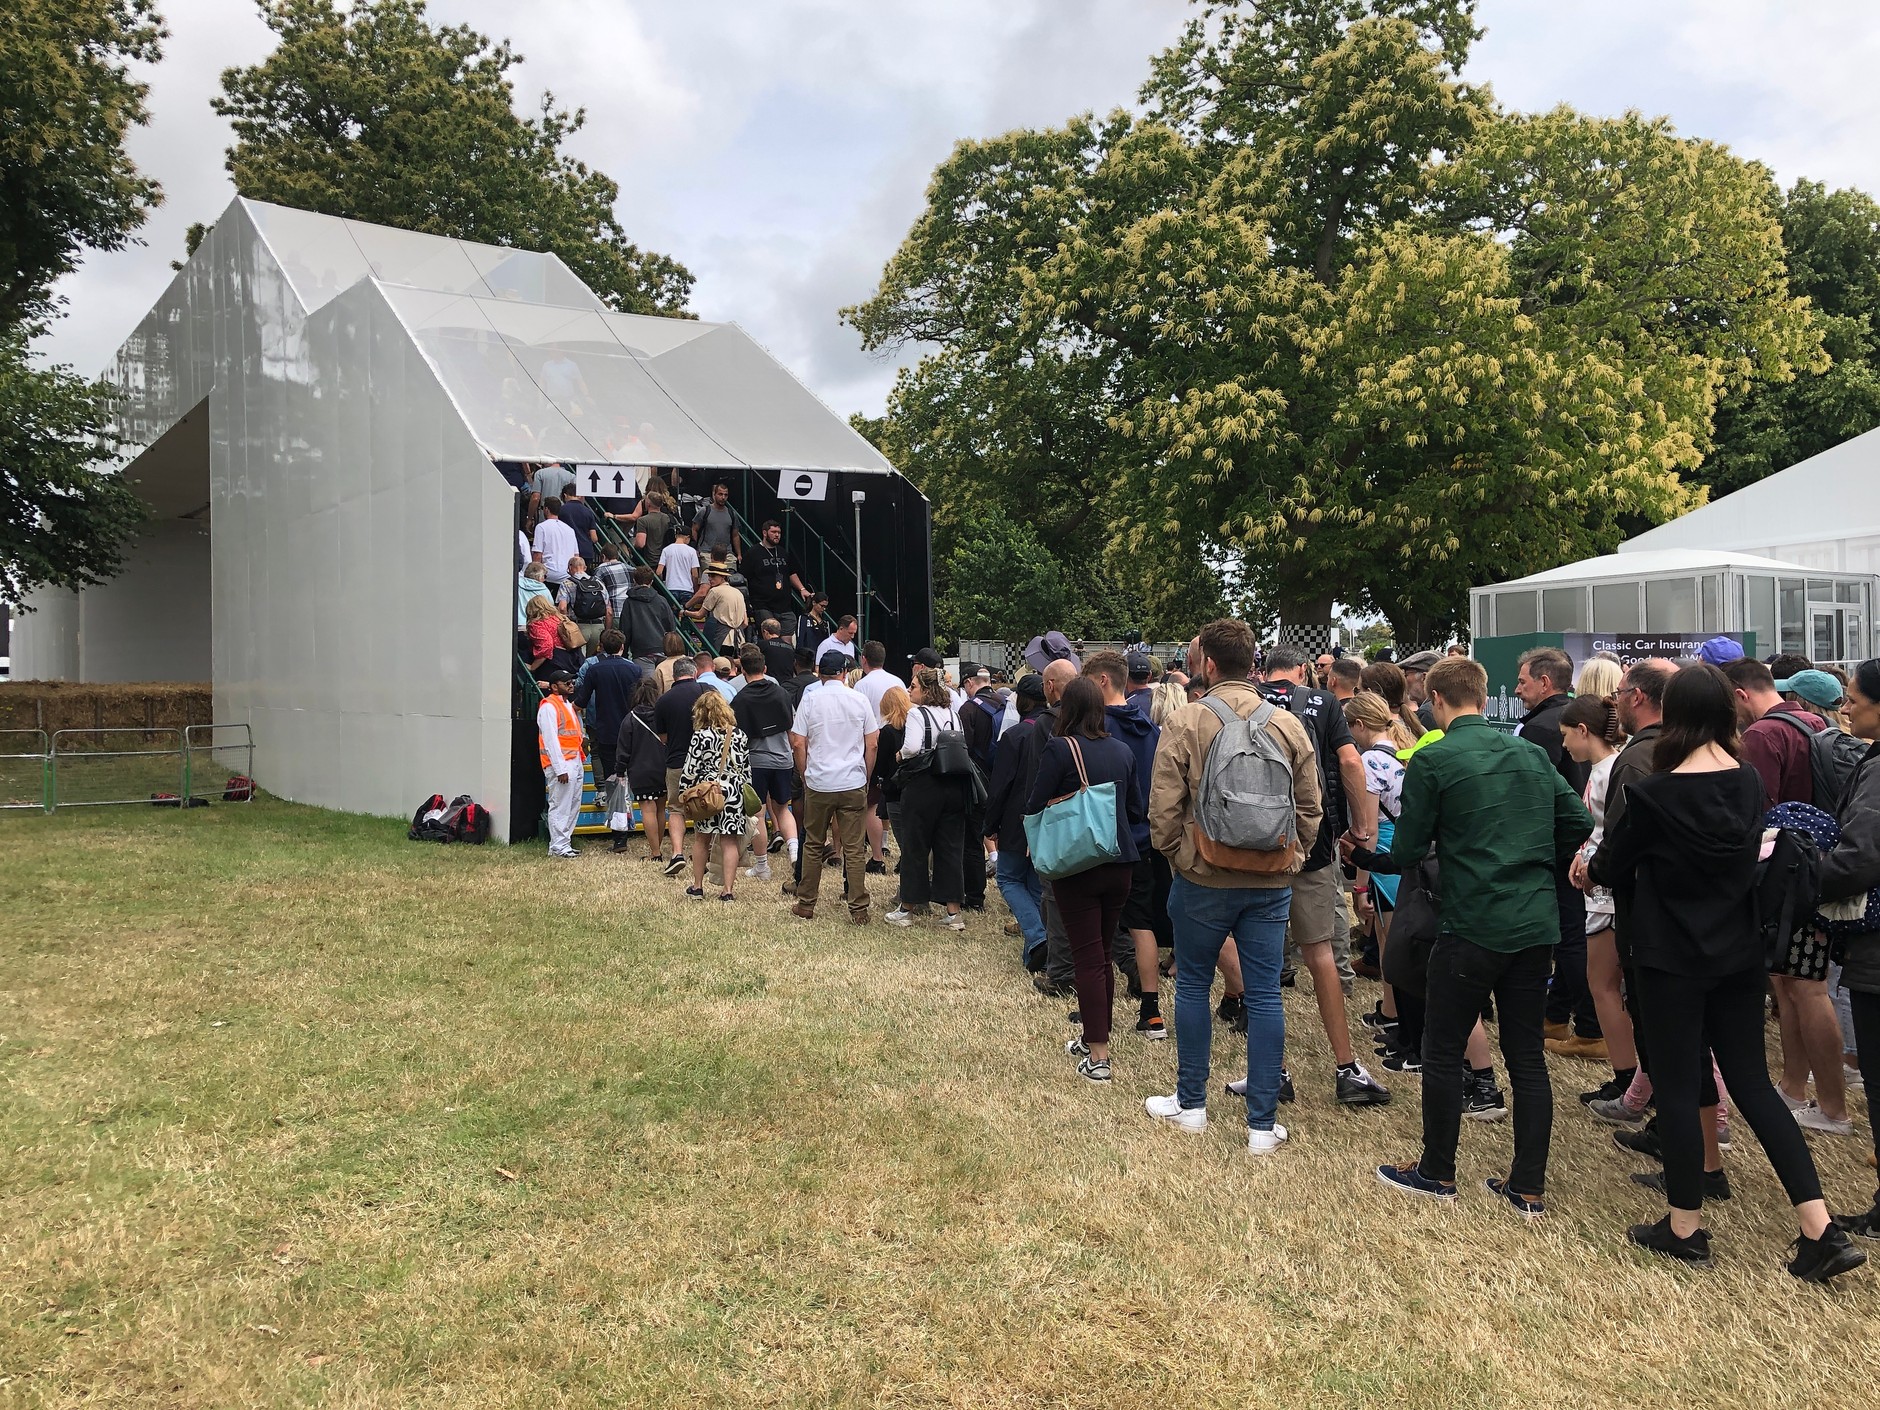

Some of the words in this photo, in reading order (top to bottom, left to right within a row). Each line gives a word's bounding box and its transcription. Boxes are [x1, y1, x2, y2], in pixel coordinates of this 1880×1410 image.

[1593, 640, 1631, 650] Classic
[1635, 640, 1655, 650] Car
[1659, 639, 1707, 650] Insuranc
